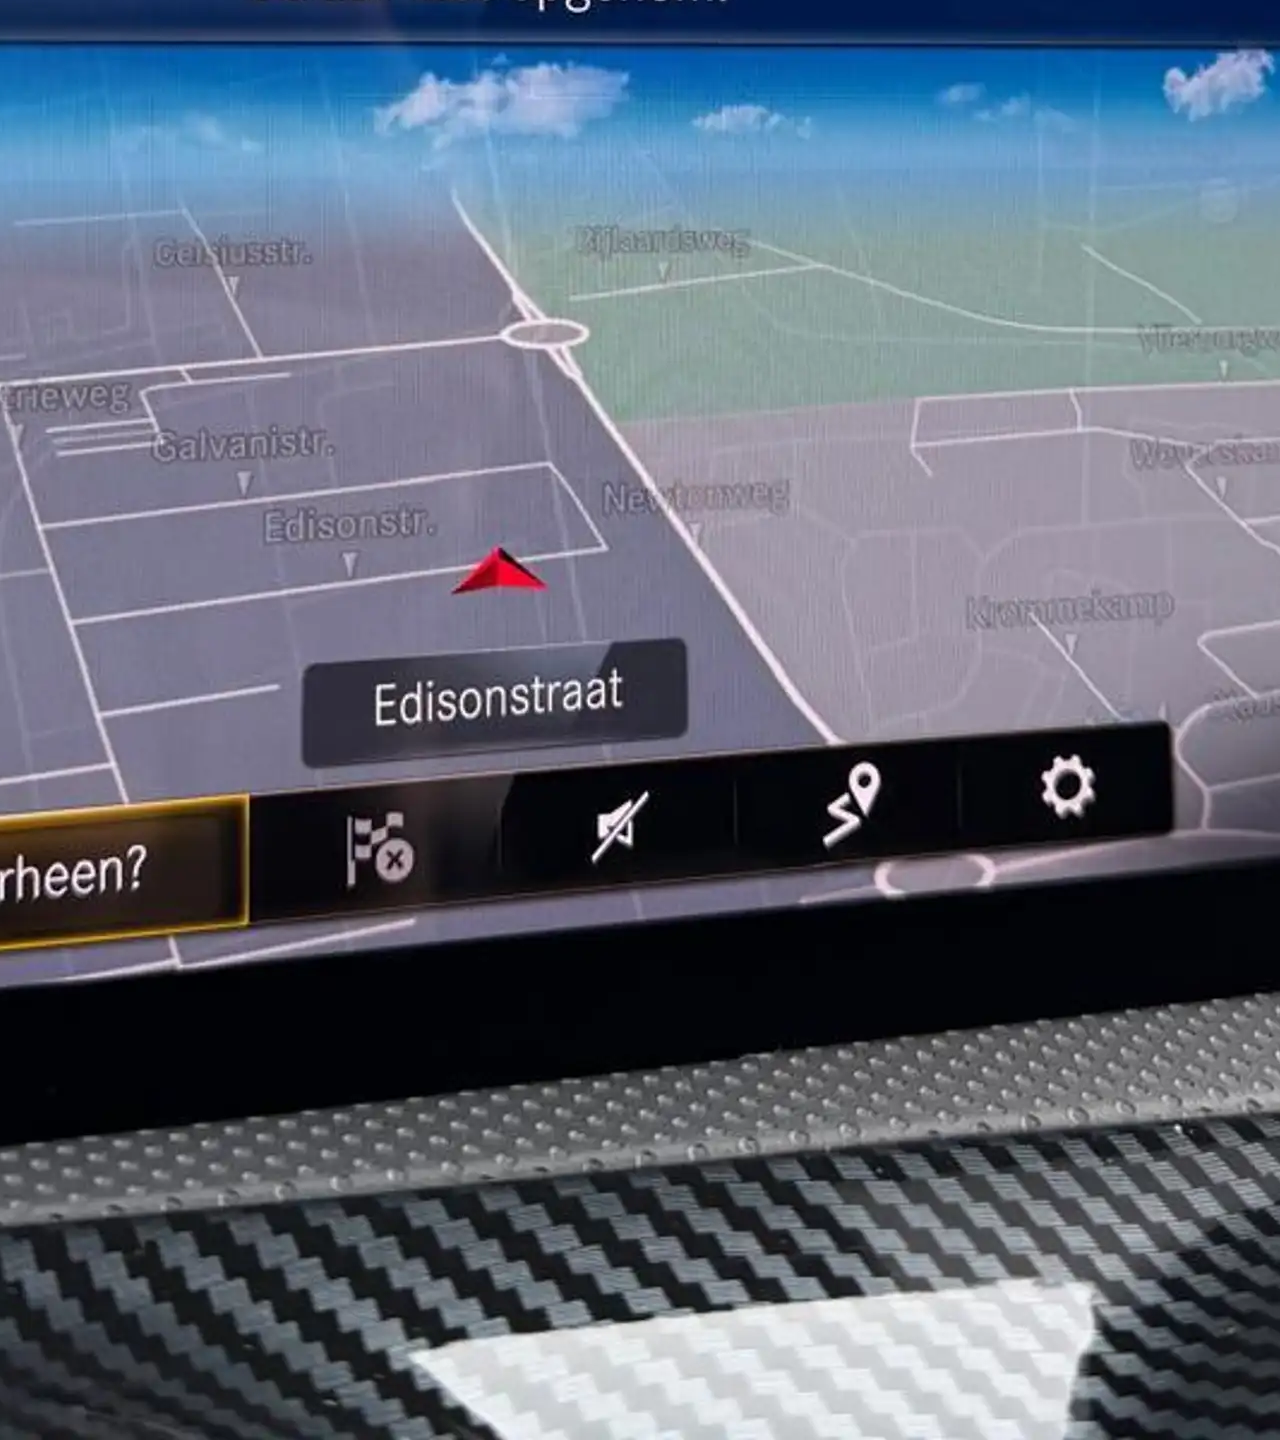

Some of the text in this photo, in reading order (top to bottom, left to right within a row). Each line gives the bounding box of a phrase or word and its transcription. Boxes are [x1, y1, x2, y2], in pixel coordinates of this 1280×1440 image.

[152, 237, 313, 268] Celsiusstr.
[151, 426, 336, 464] Galvanistr.
[602, 478, 792, 517] Newtonweg
[263, 506, 438, 546] Edisonstr.
[373, 668, 624, 728] Edisonstraat
